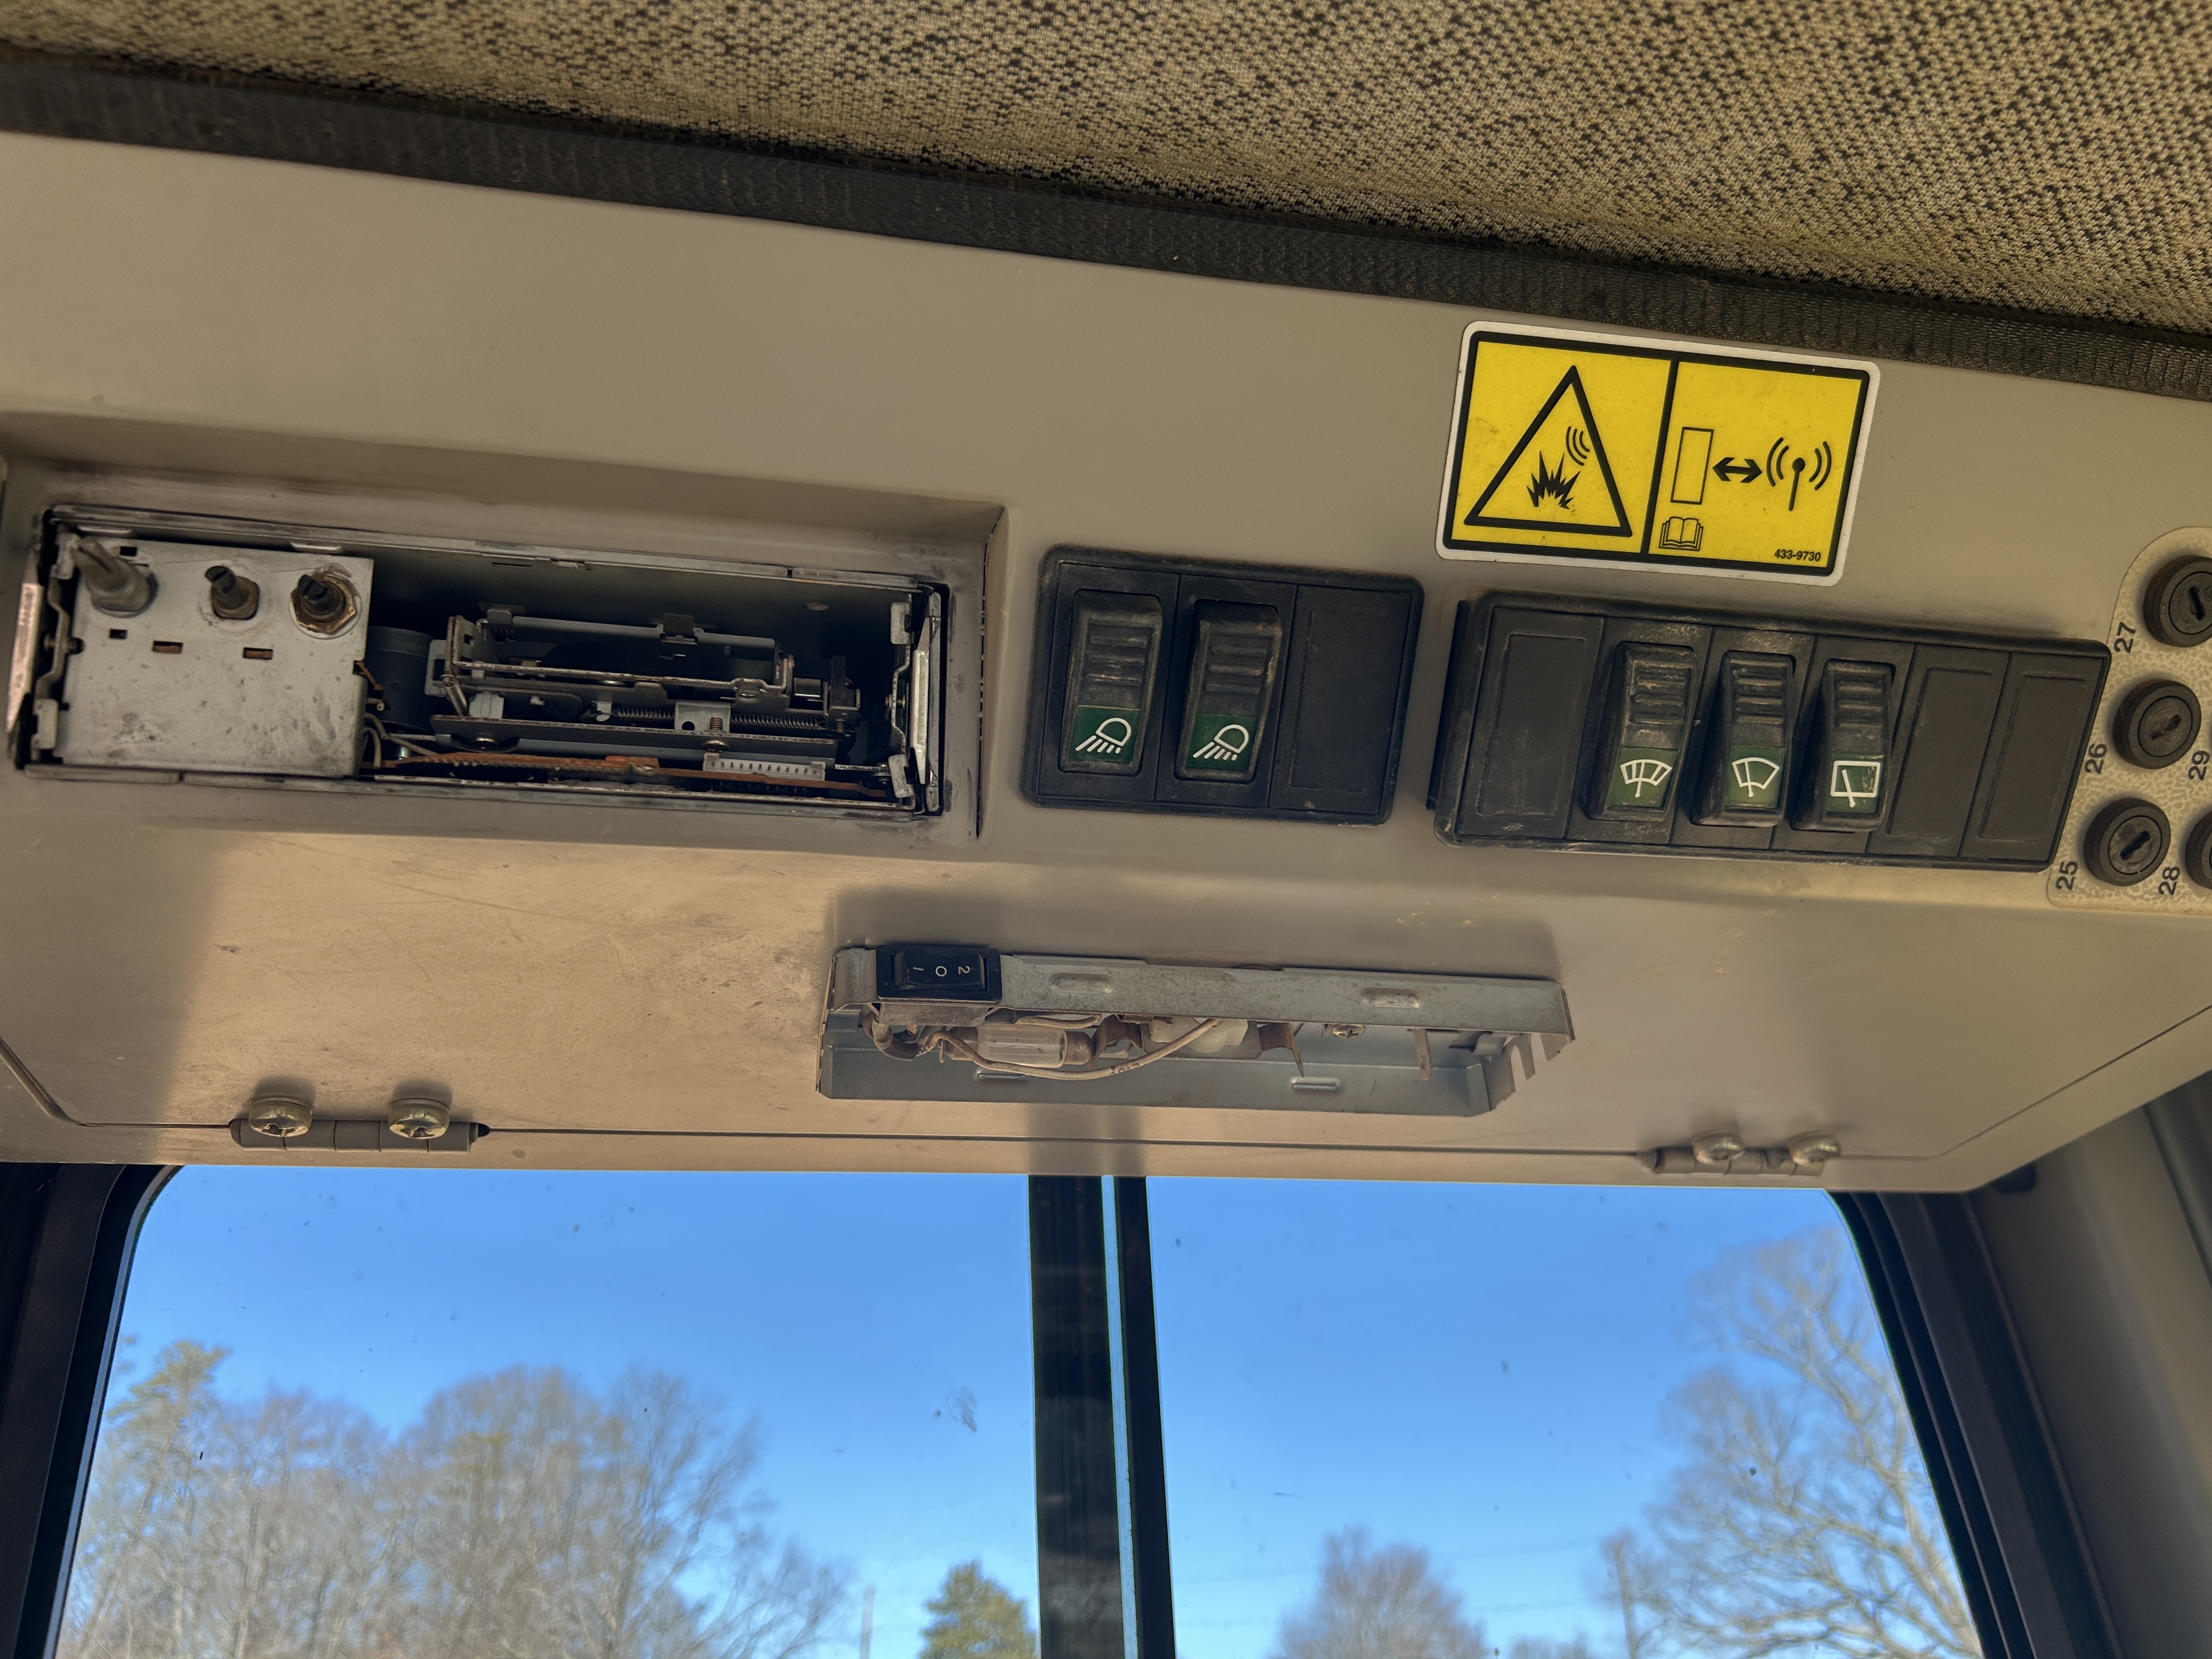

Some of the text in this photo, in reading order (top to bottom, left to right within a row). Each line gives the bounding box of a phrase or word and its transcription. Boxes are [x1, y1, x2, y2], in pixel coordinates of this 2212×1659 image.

[1774, 549, 1821, 562] 433-9730
[2114, 622, 2136, 653] 27
[2084, 743, 2107, 774] 26
[2188, 751, 2210, 781] 29
[2055, 861, 2078, 890] 25
[2158, 866, 2180, 895] 28
[958, 965, 971, 975] 2
